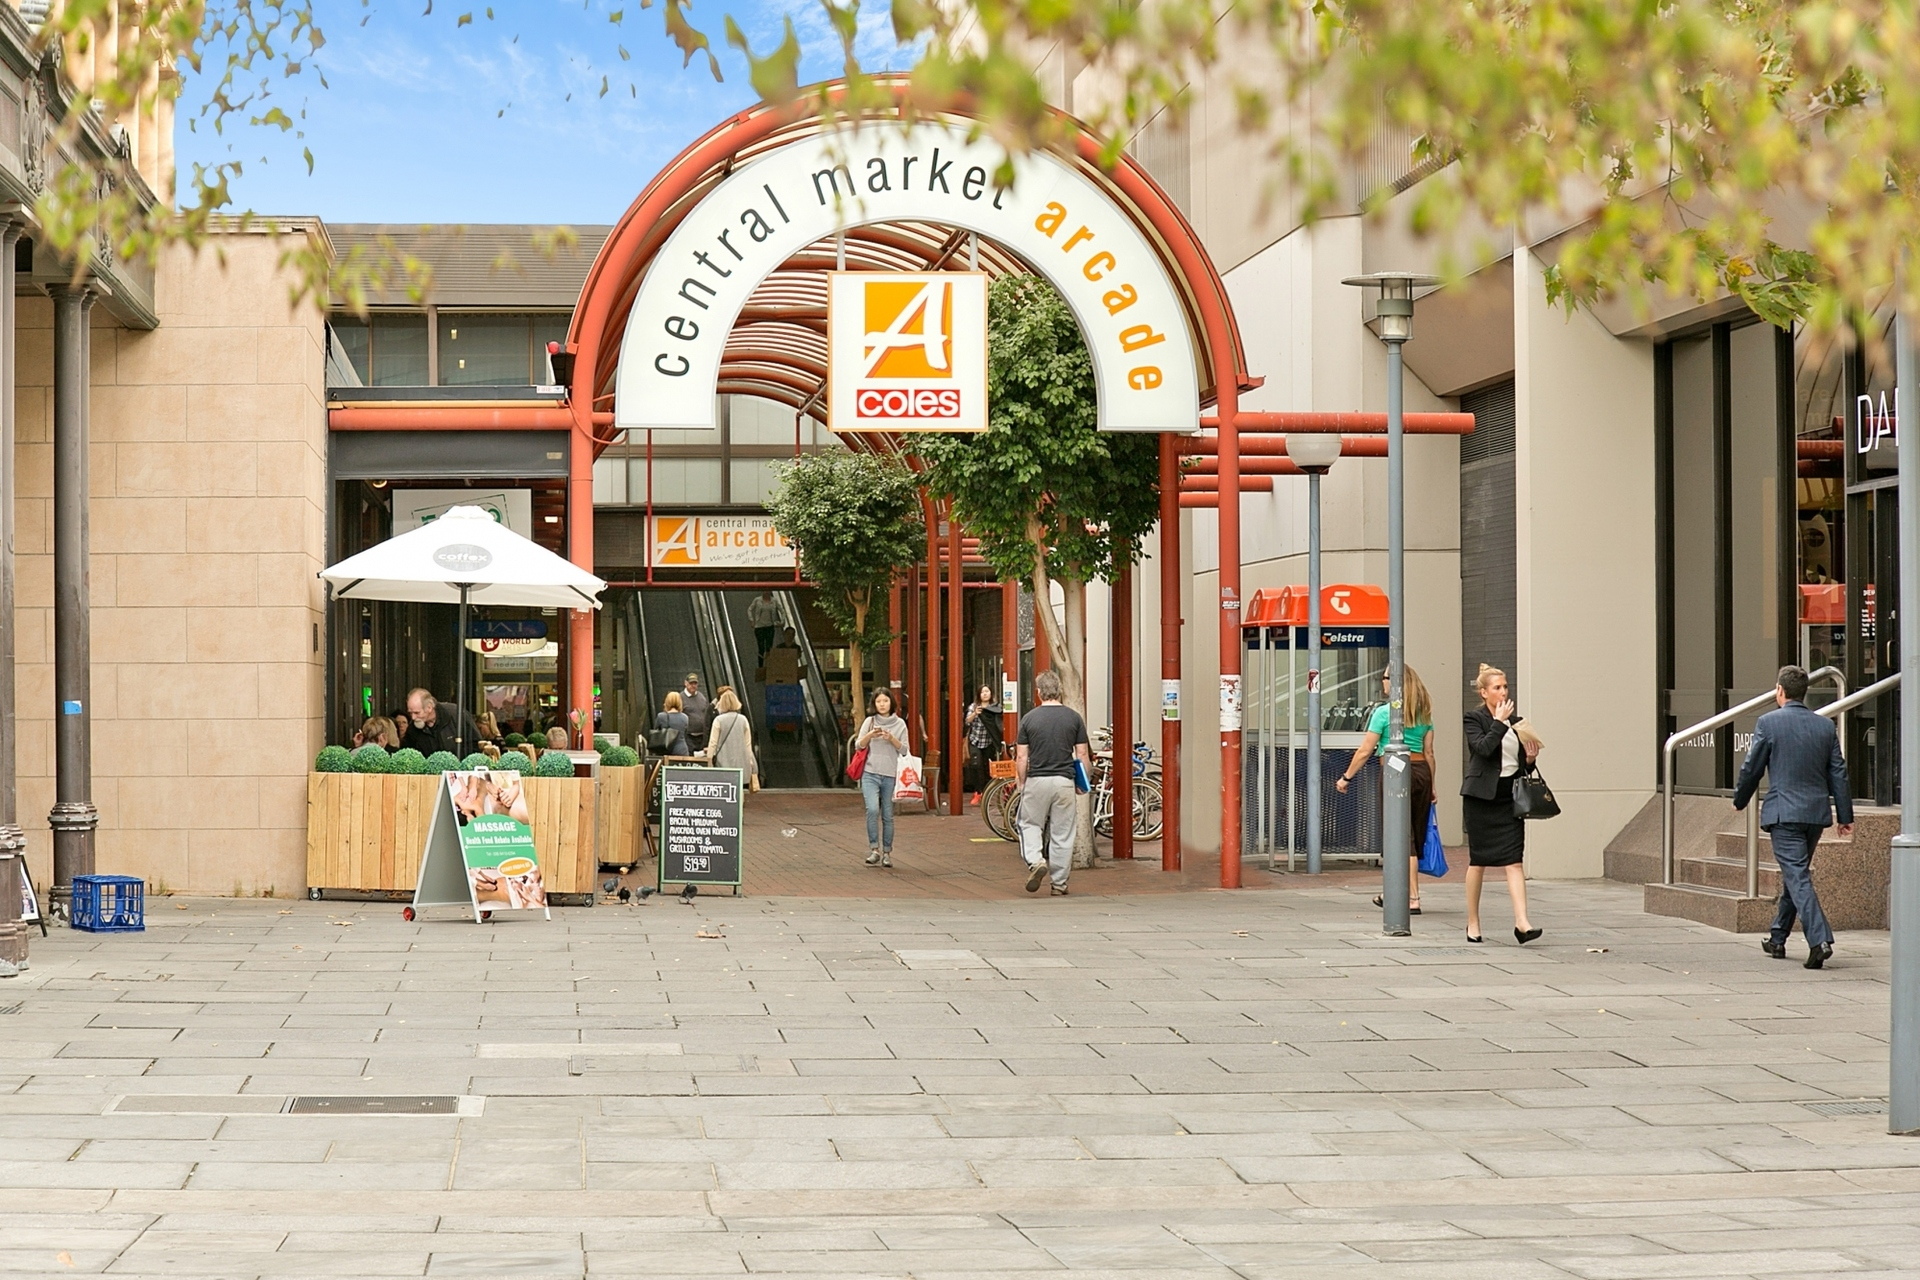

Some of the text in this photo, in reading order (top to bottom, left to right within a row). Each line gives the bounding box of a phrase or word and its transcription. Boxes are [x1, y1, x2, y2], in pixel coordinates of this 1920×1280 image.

[654, 184, 792, 377] central
[1034, 200, 1166, 391] arcade
[858, 391, 959, 417] coles
[1857, 387, 1899, 454] DA
[706, 518, 747, 528] central
[438, 553, 488, 561] coffex
[1321, 632, 1365, 645] Telstra
[473, 822, 517, 832] MASSAGE
[695, 827, 711, 835] OVEN
[712, 827, 738, 837] ROASTED
[465, 836, 481, 845] Health
[511, 835, 532, 844] Available
[669, 836, 703, 845] MUSHROOMS
[669, 844, 695, 853] GRILLED
